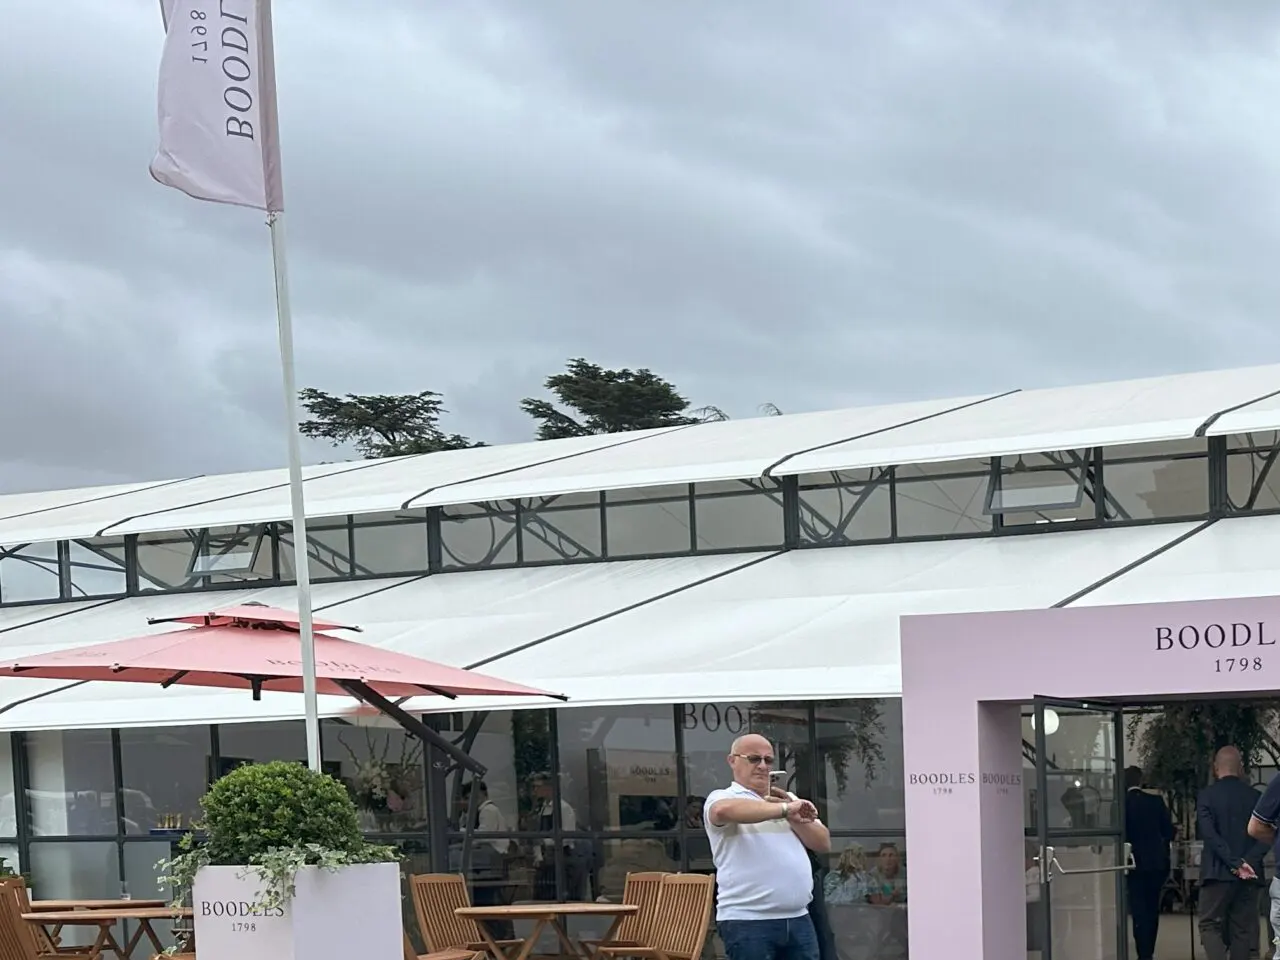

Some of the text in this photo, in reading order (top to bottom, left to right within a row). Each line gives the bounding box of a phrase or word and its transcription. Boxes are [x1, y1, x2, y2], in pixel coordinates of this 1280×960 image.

[1214, 657, 1263, 673] 1798
[909, 773, 976, 785] BOODLES
[982, 772, 1022, 786] BOODLES
[933, 787, 953, 795] 1798
[231, 922, 257, 932] 1798
